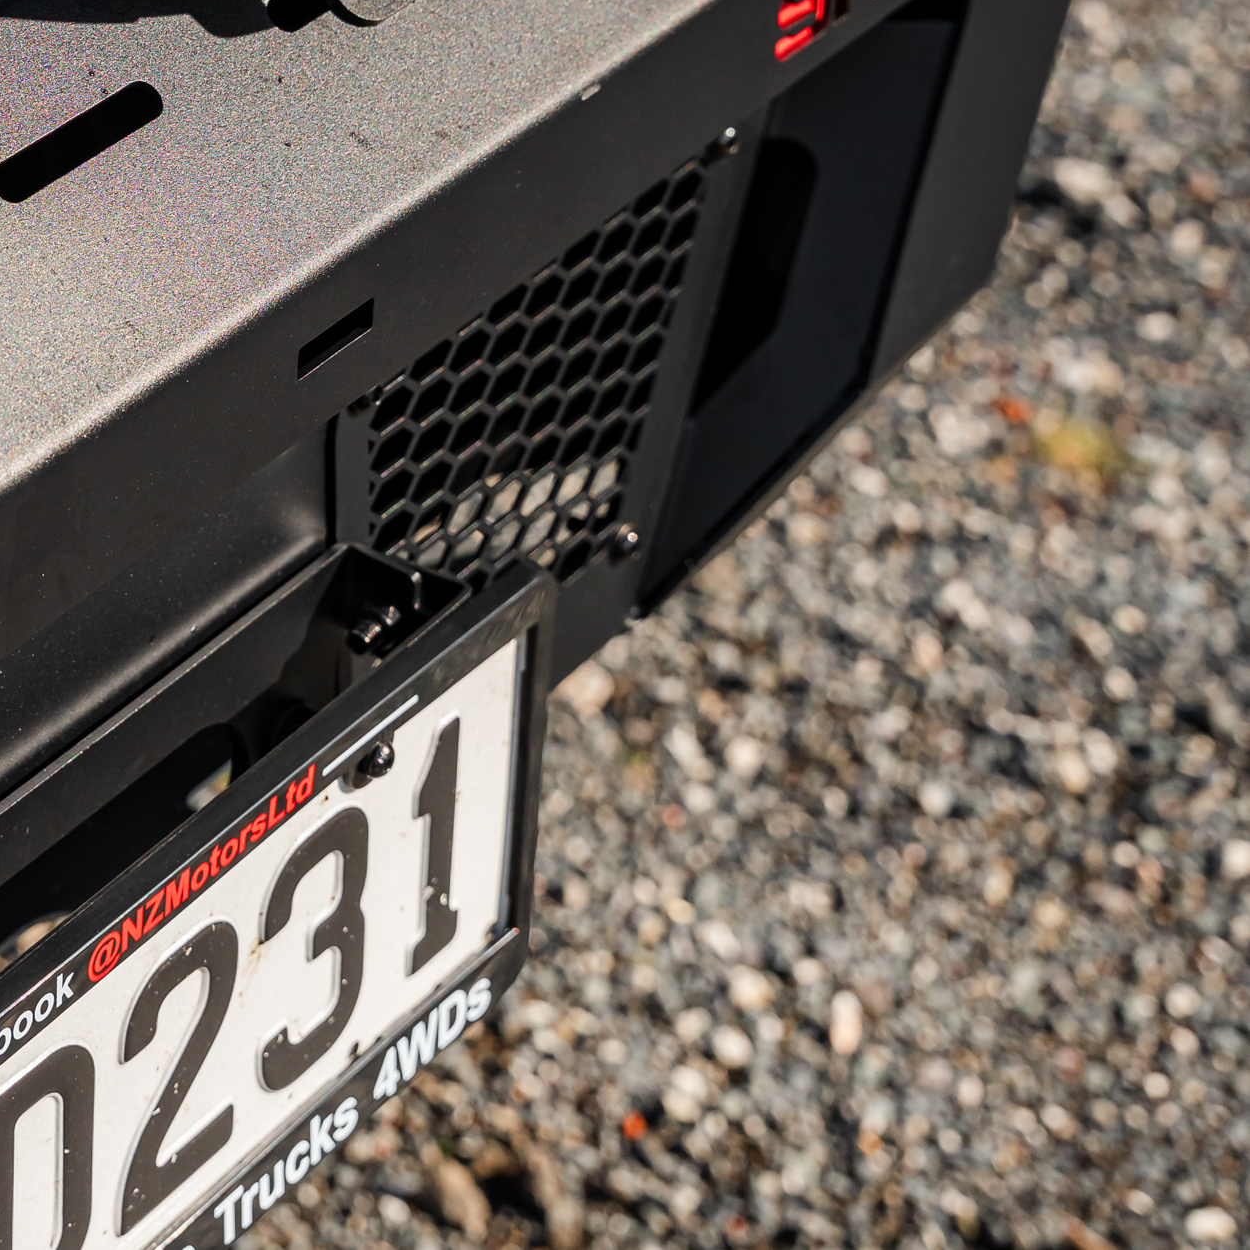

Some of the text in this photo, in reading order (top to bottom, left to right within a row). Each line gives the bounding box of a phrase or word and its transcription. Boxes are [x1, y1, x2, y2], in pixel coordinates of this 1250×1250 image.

[87, 762, 316, 982] @NZMotorsLtd
[213, 977, 492, 1246] Trucks 4WDs
